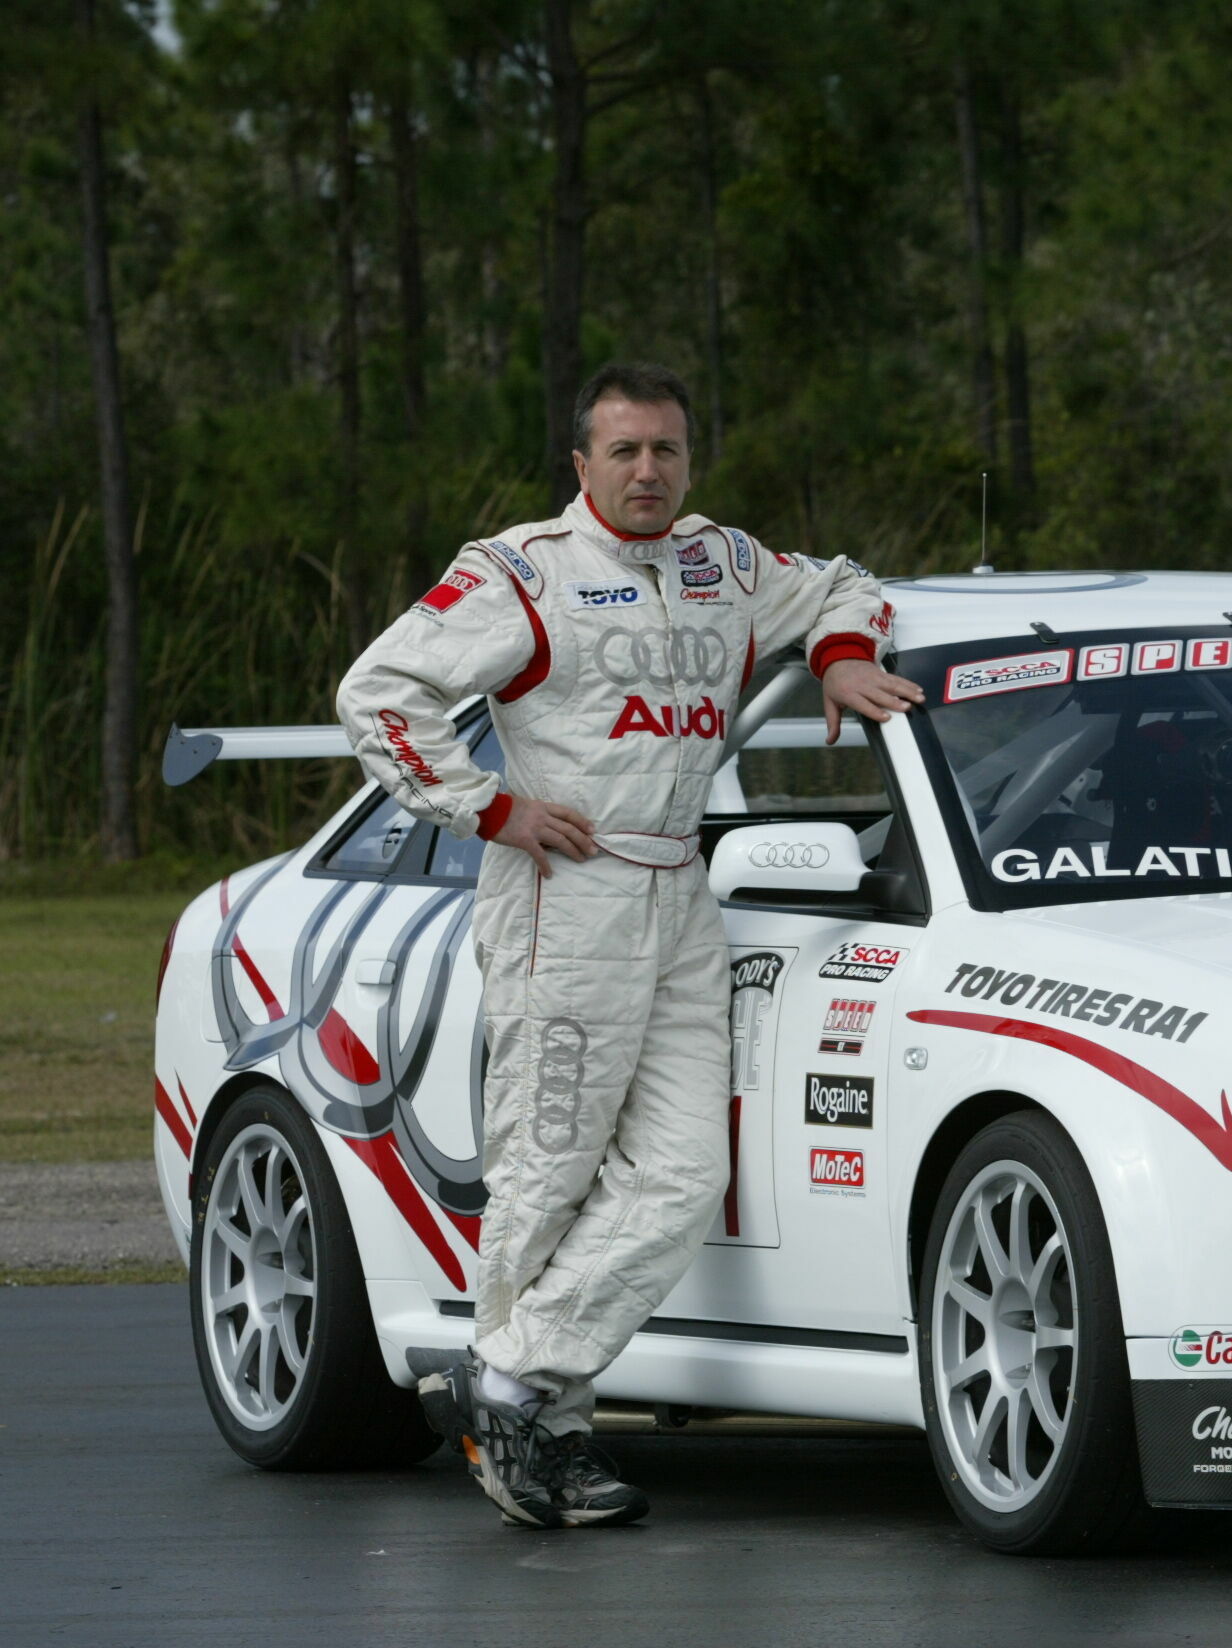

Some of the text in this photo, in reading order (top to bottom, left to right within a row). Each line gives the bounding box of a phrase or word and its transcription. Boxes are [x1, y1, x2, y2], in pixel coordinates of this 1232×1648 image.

[578, 586, 638, 605] TOYO
[960, 668, 1059, 689] PRO RACING
[985, 661, 1058, 676] SCCA
[608, 695, 727, 740] Audi
[378, 709, 443, 788] Champion
[990, 846, 1232, 883] GALATI
[850, 946, 901, 966] SCCA
[731, 956, 780, 988] ODY'S
[820, 963, 890, 980] PRO RACING
[944, 962, 1209, 1044] TOYO TIRES RA1
[825, 1006, 873, 1031] SPEED
[810, 1077, 869, 1122] Rogaine
[812, 1153, 862, 1182] MoTeC
